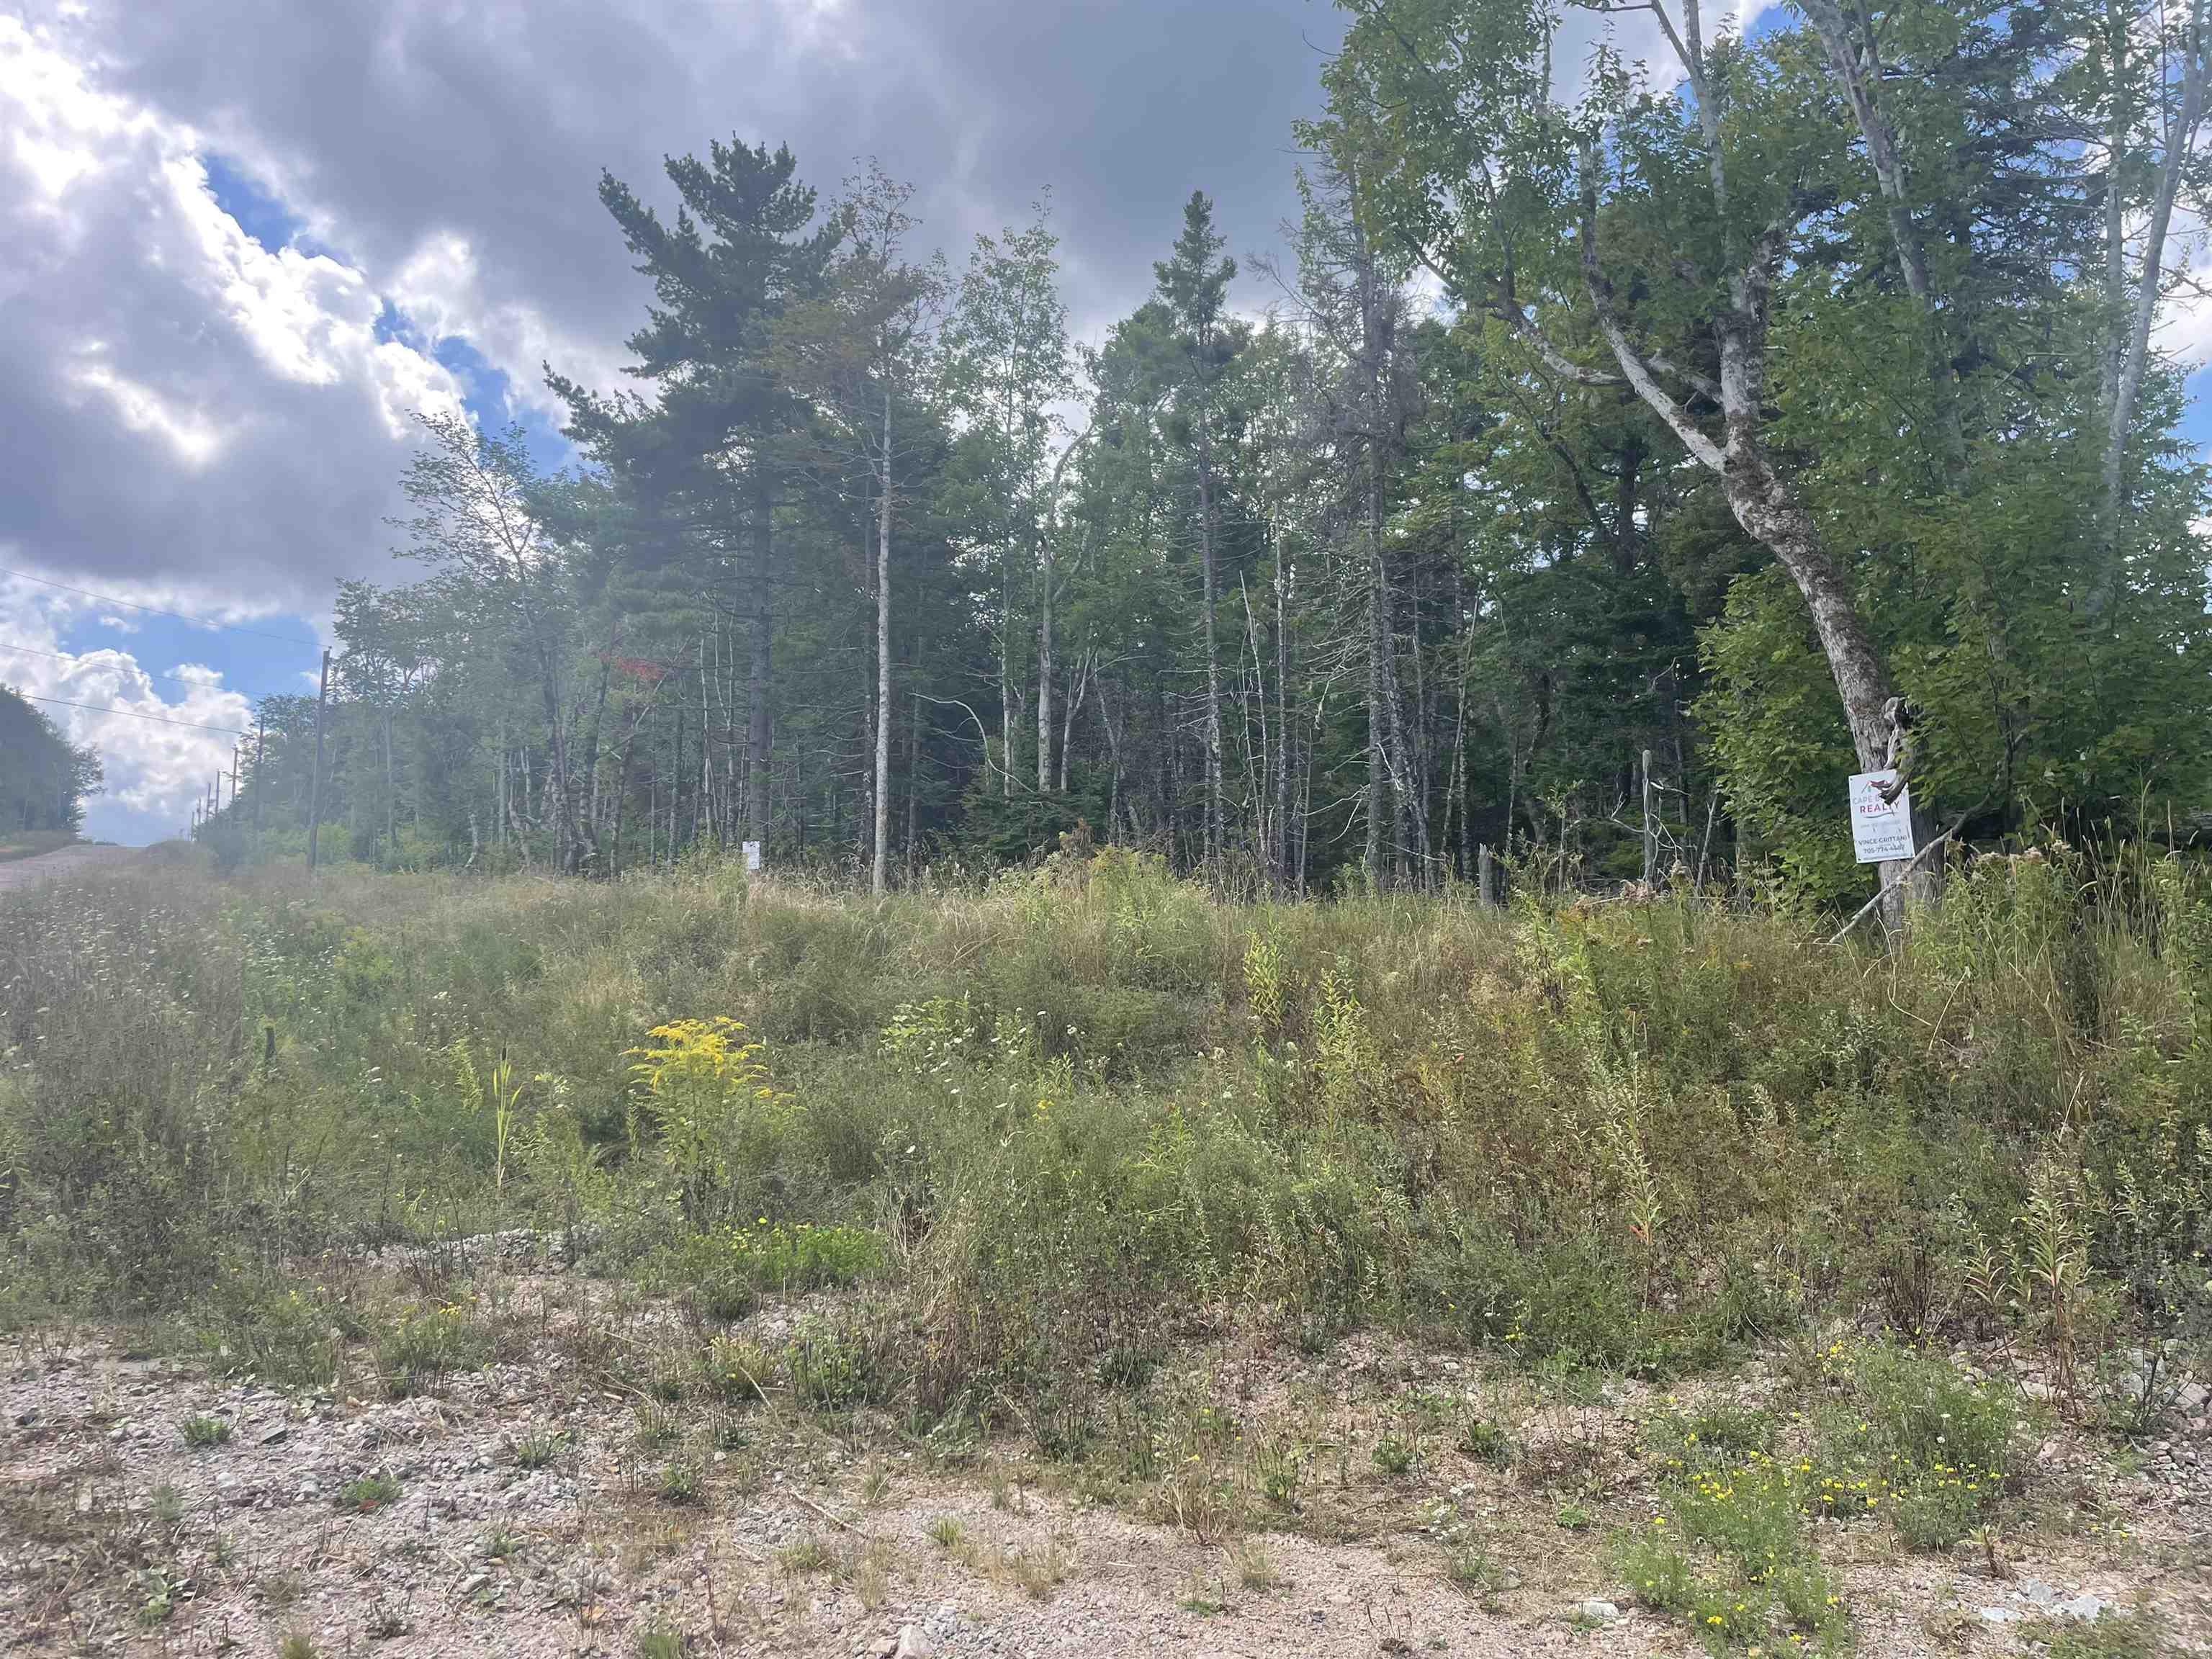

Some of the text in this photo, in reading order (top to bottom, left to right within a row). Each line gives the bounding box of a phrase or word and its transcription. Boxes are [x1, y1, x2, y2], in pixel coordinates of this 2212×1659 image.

[1853, 794, 1874, 805] CAPE
[1860, 801, 1899, 814] REALTY
[1858, 837, 1878, 846] VINCE
